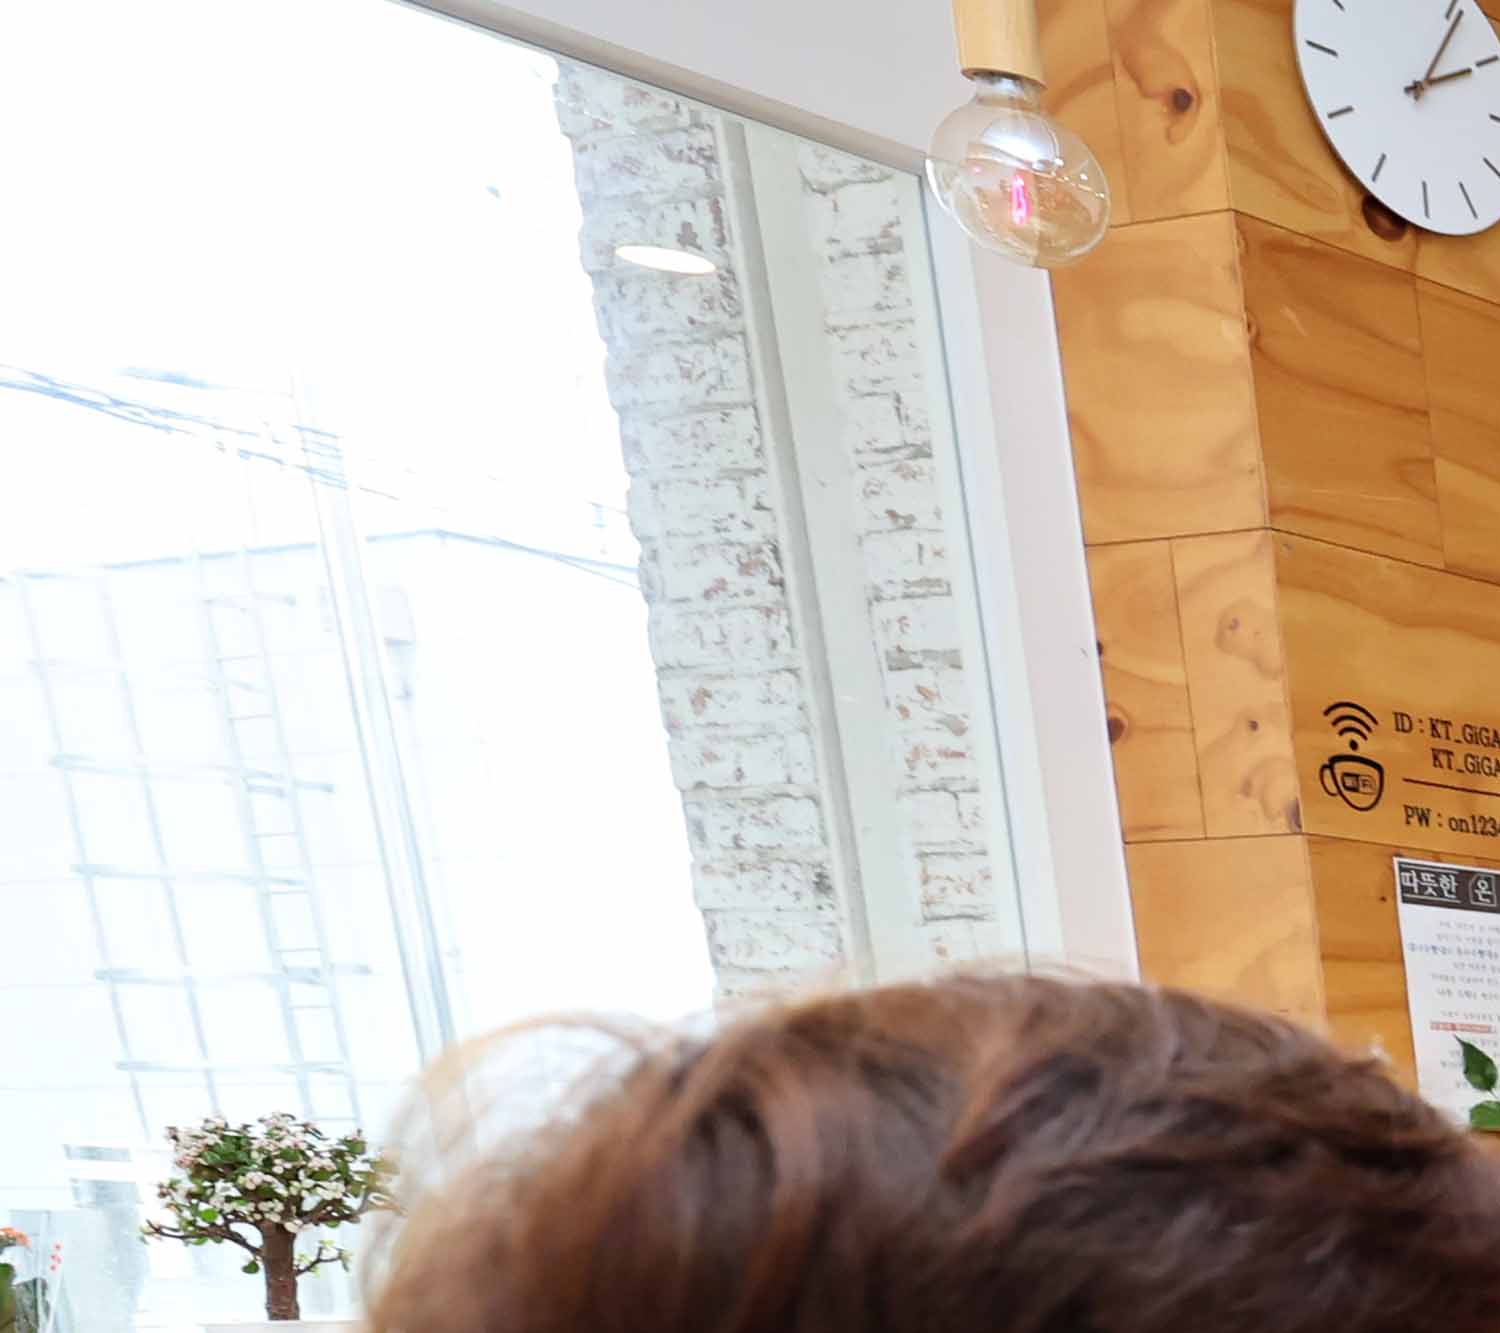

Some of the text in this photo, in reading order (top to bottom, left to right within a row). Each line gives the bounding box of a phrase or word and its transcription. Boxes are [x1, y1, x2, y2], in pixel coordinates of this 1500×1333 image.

[1393, 711, 1413, 733] ID
[1403, 804, 1431, 828] PW
[1401, 869, 1458, 899] 따뜻한
[1475, 879, 1494, 903] 온
